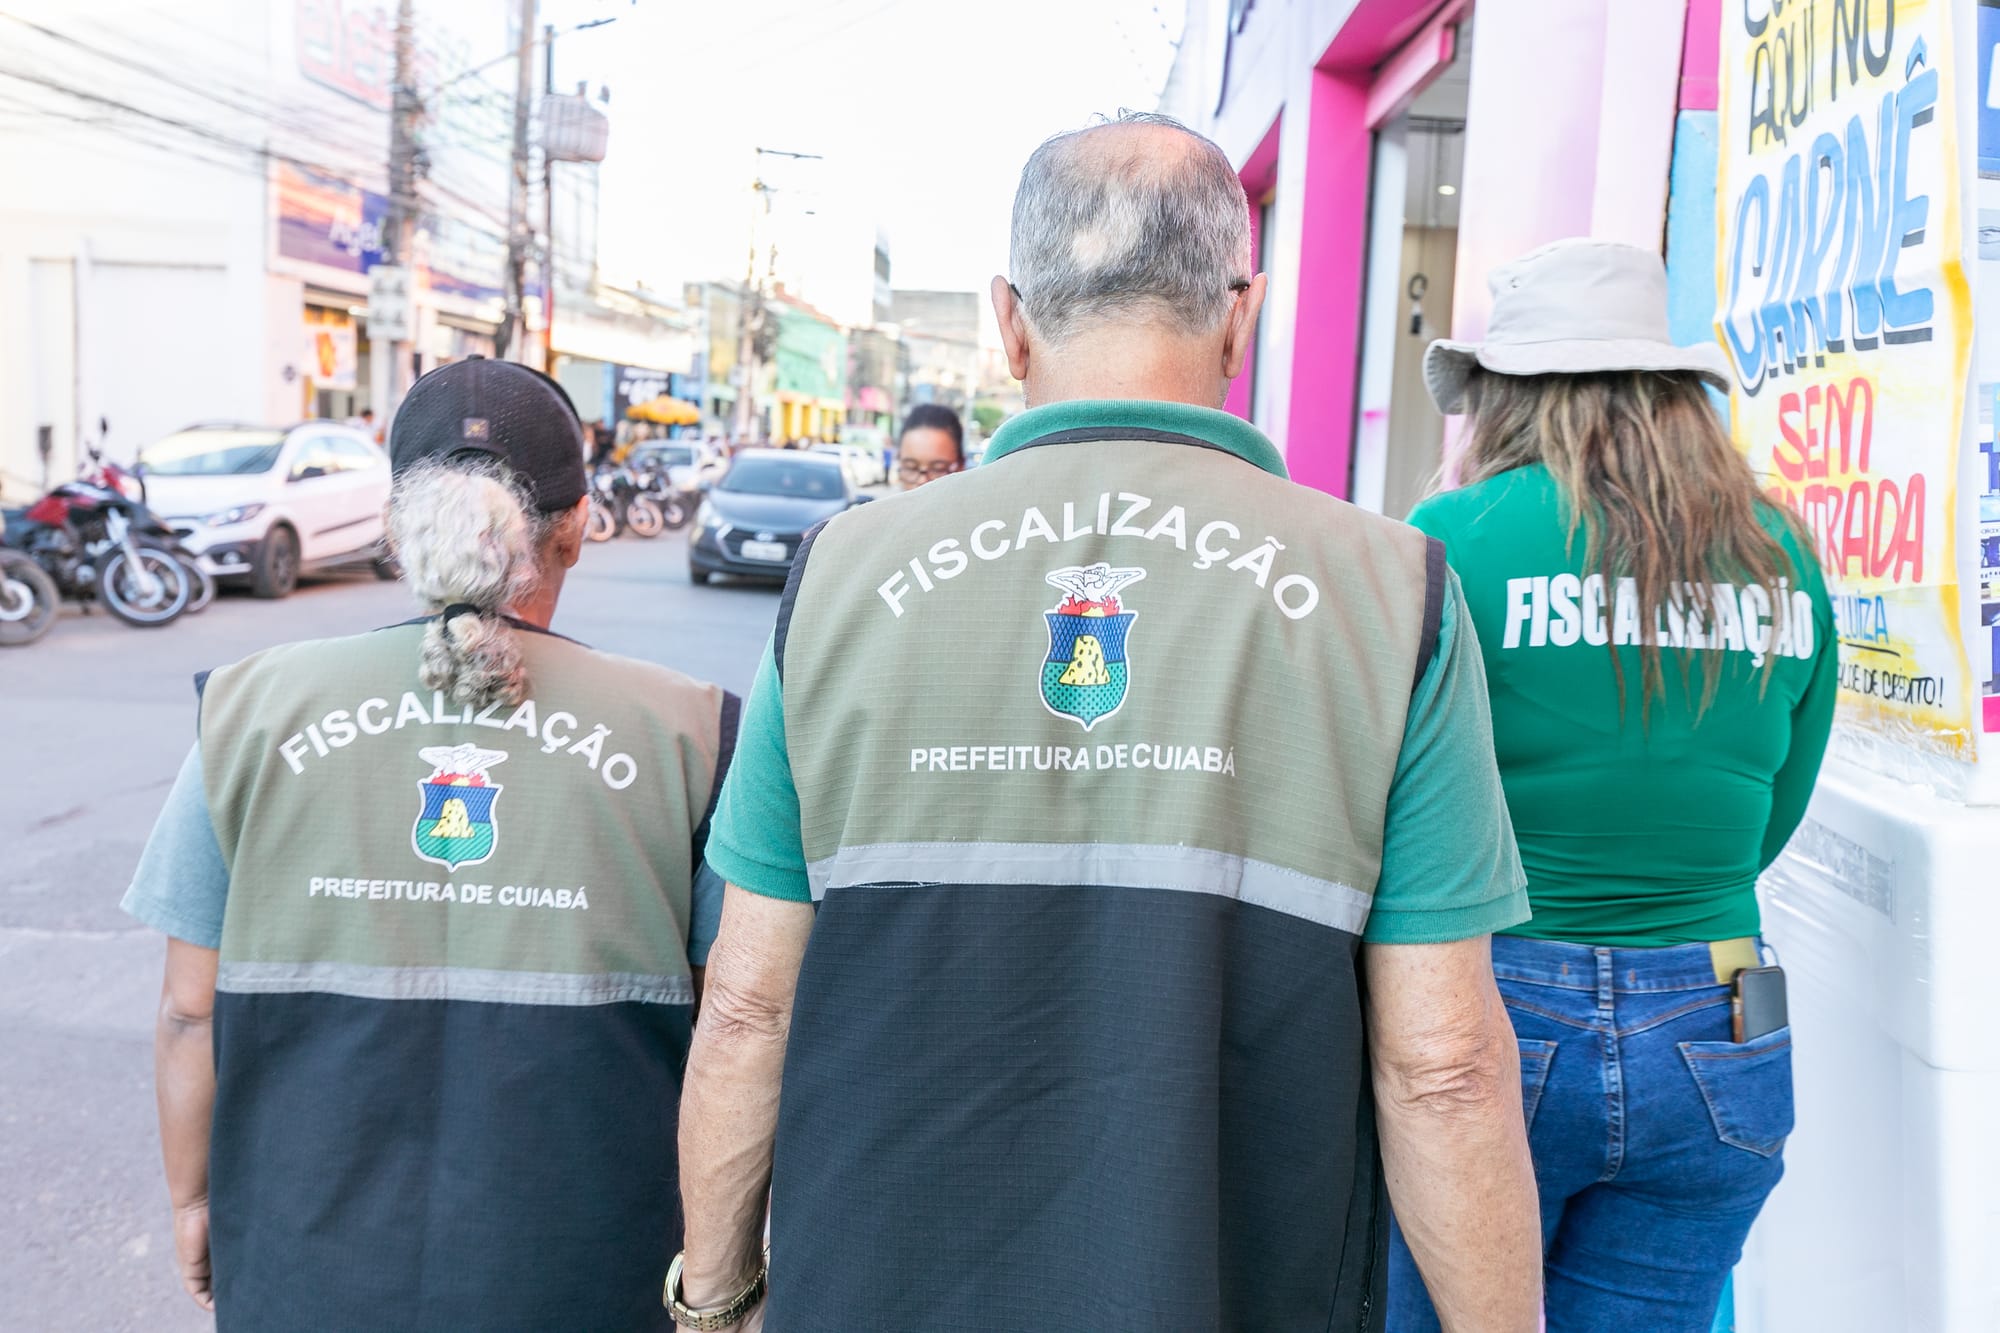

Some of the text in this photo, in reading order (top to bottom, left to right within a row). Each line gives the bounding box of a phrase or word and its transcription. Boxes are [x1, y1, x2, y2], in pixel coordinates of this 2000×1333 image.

[1748, 0, 1815, 154] AQUI
[1725, 34, 1938, 396] CARNÊ
[1772, 377, 1873, 481] SEM
[877, 492, 1320, 620] FISCALIZAÇÃO
[1766, 473, 1925, 583] TRADA
[910, 743, 1236, 776] PREFEITURA DE CUIABÁ
[309, 877, 589, 910] PREFEITURA DE CUIABÁ
